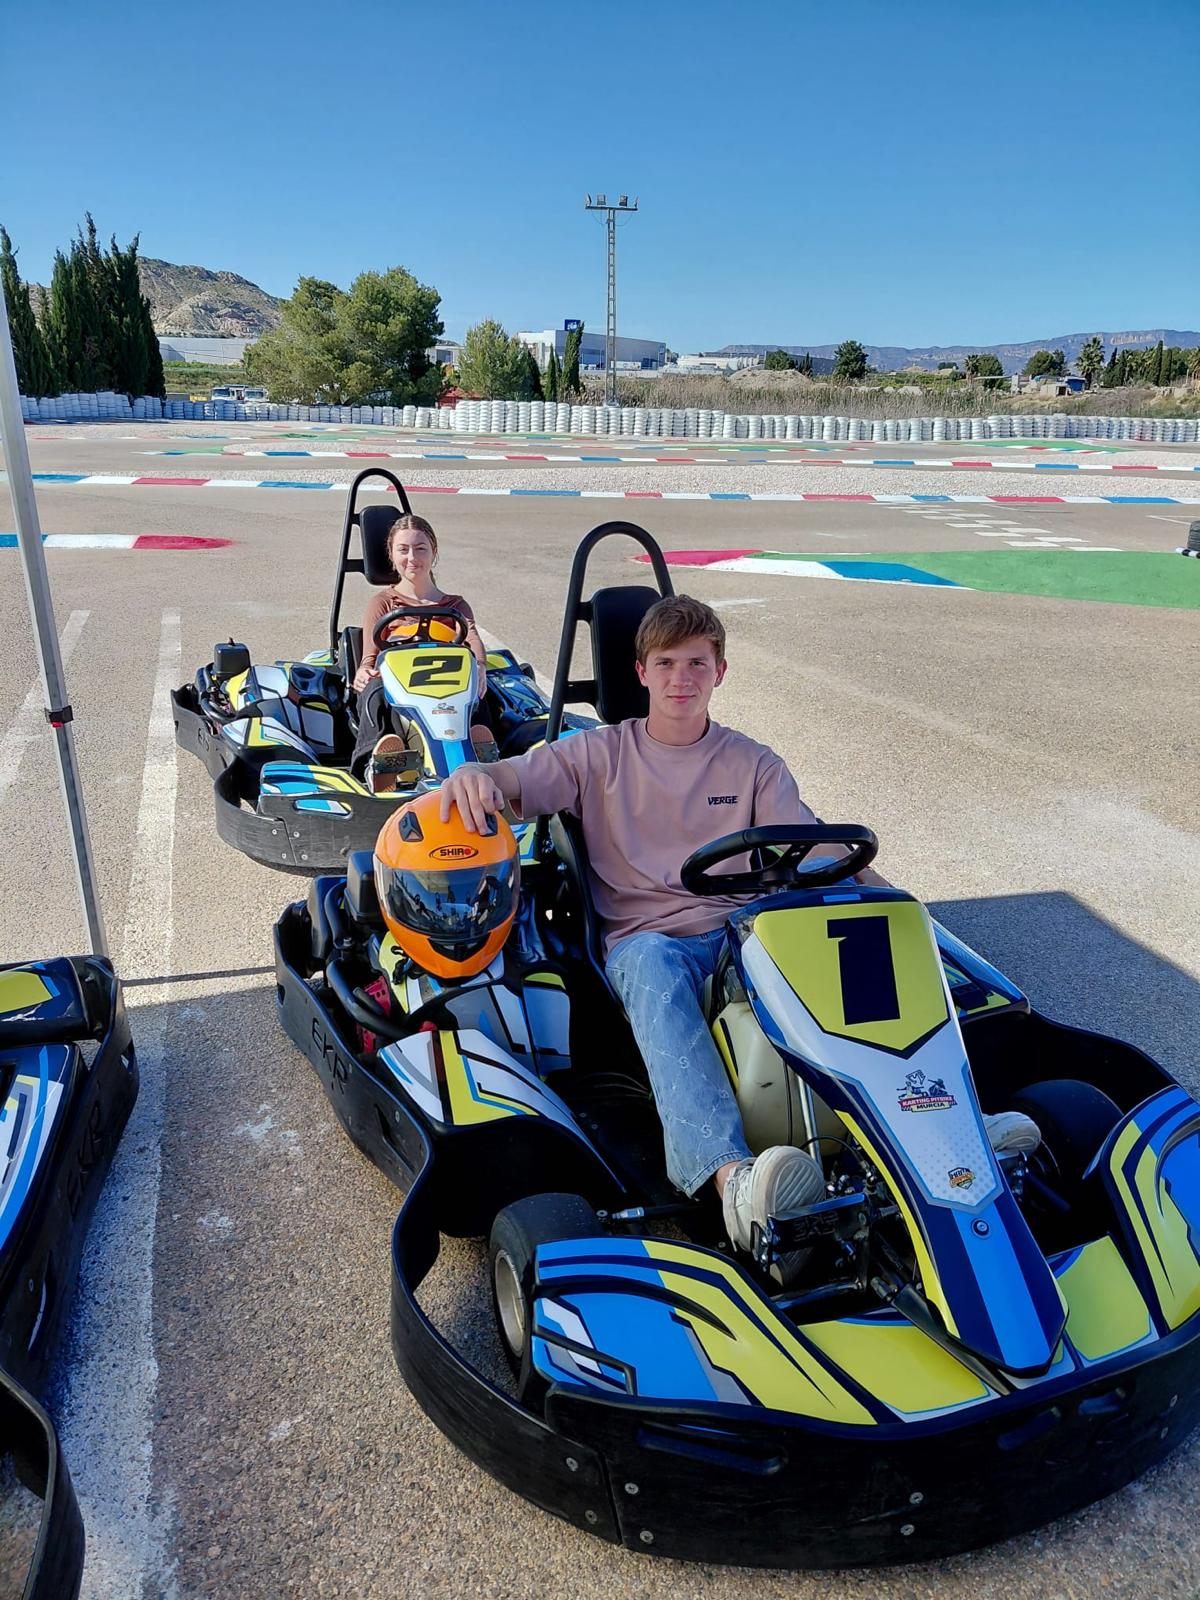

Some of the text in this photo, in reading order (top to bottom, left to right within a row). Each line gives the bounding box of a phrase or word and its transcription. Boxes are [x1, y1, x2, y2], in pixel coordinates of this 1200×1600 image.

[408, 655, 463, 687] 2
[707, 795, 738, 806] VERGE
[439, 847, 472, 857] SHIRO
[827, 915, 901, 1026] 1
[312, 1017, 348, 1096] EKR
